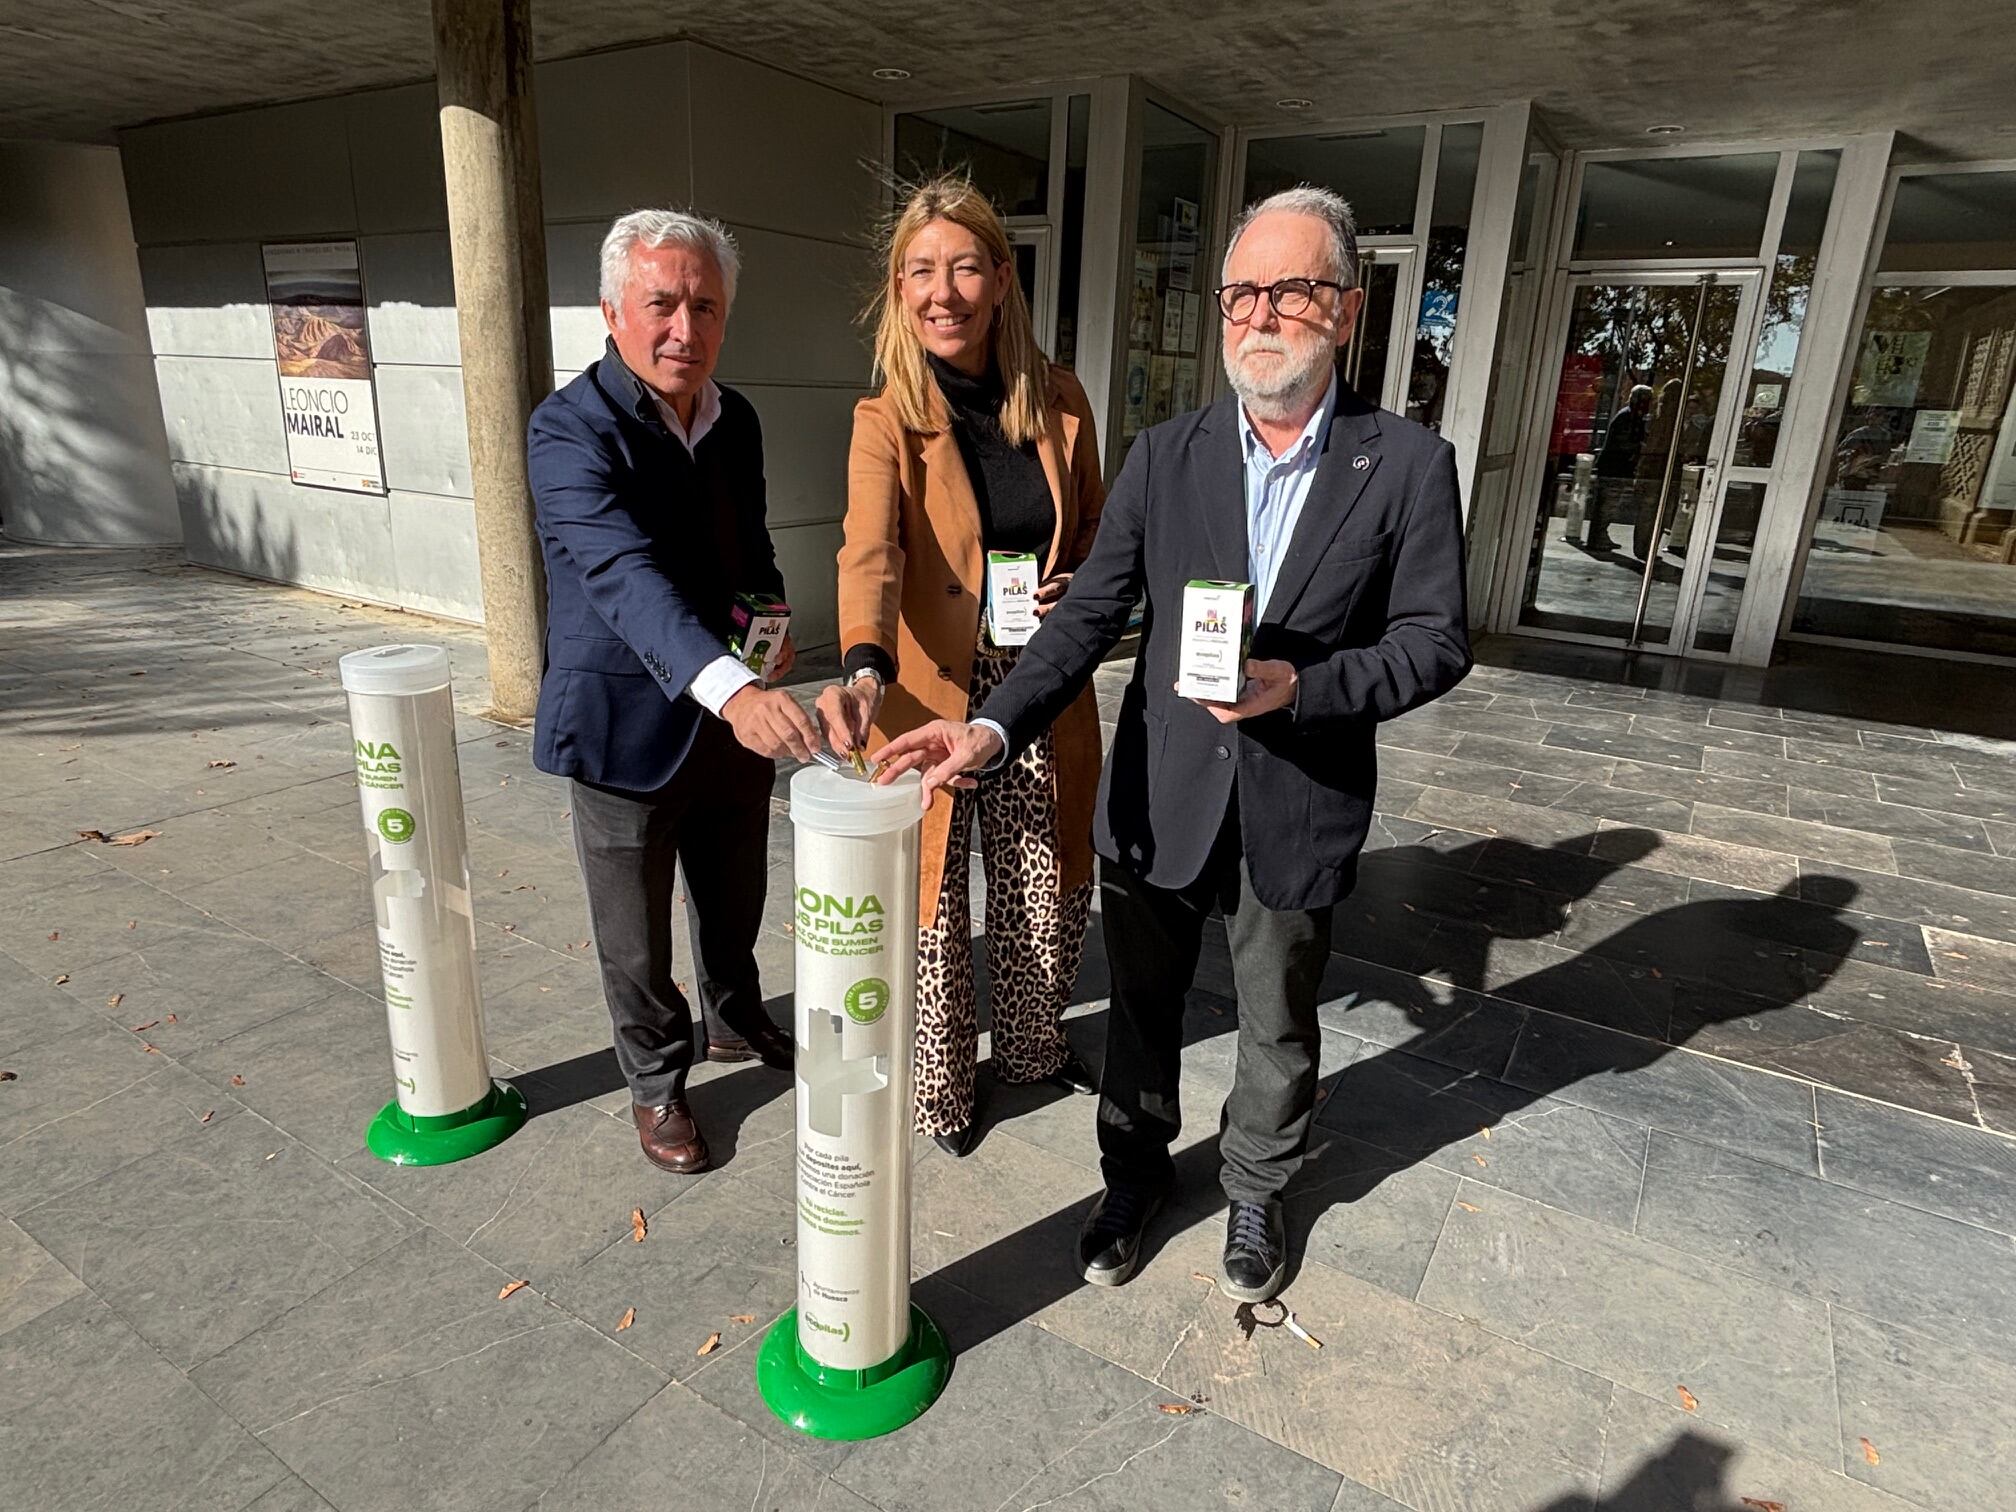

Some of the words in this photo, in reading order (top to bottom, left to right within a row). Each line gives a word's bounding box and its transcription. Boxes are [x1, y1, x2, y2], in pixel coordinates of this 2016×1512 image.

[283, 387, 348, 414] LEONCIO
[286, 412, 344, 439] MAIRAL
[351, 431, 359, 440] 23
[1003, 587, 1027, 596] PILAS
[759, 627, 780, 635] PILAS
[1195, 621, 1227, 634] PILAS
[387, 819, 404, 832] 5
[815, 918, 884, 935] PILAS
[807, 931, 829, 945] QUE
[832, 937, 878, 946] SUMEN
[815, 944, 829, 954] EL
[859, 991, 878, 1010] 5
[815, 1150, 832, 1160] cada
[834, 1155, 849, 1163] pila
[822, 1171, 836, 1180] una
[822, 1292, 848, 1302] Huesca
